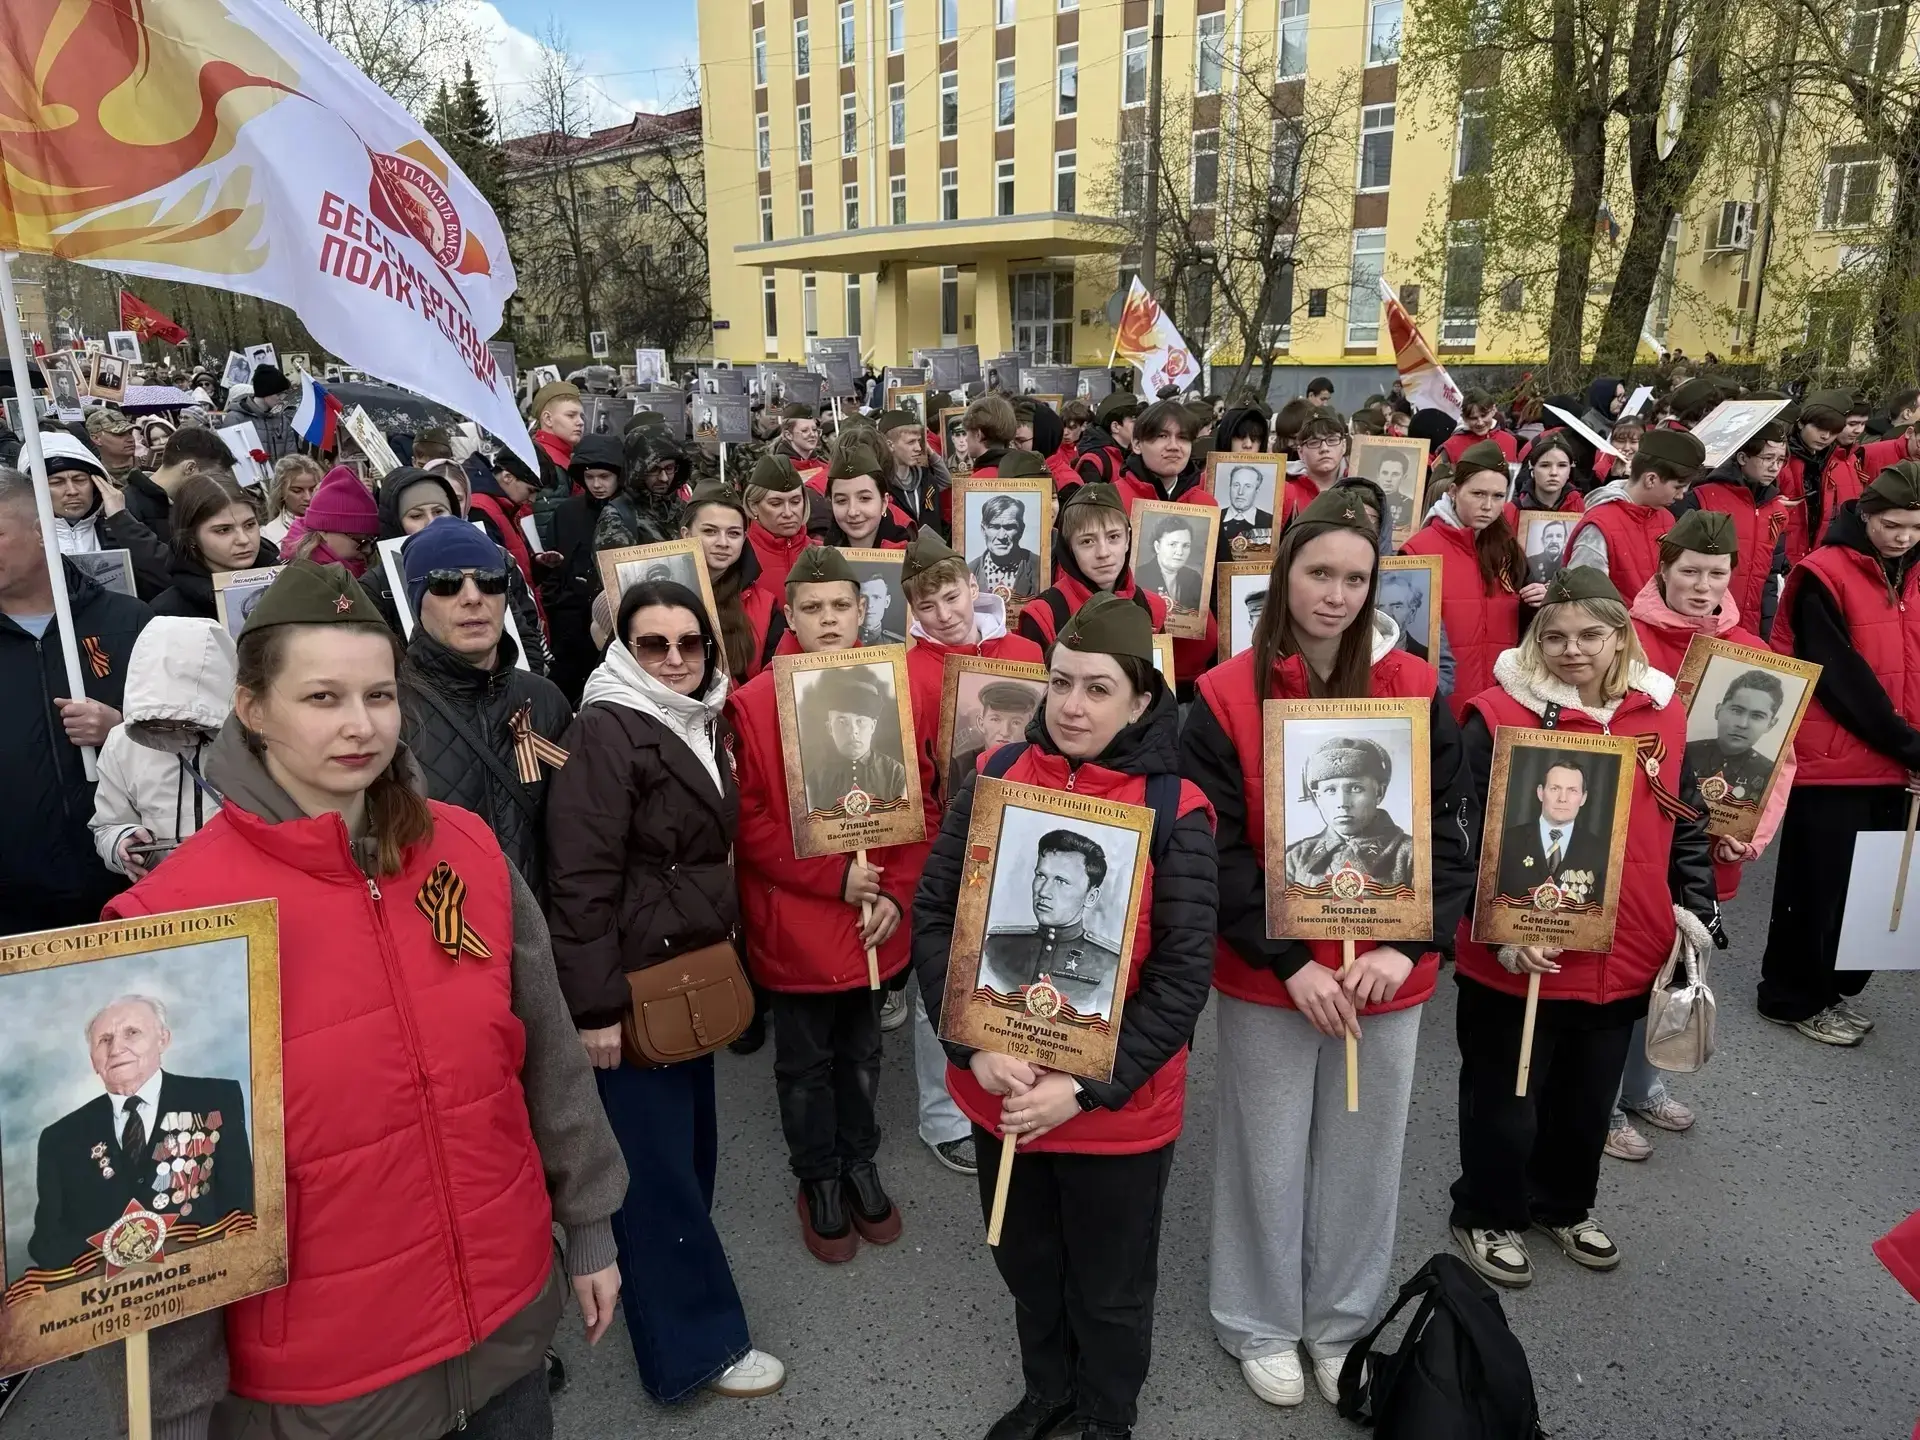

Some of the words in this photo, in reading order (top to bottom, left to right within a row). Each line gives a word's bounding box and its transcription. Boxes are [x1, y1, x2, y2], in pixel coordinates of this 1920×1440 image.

[402, 165, 454, 220] ПАМЯТЬ
[438, 223, 459, 266] ВМЕСЕ
[319, 233, 416, 311] ПОЛК
[791, 650, 861, 667] БЕССМЕРТНЫЙ
[861, 648, 889, 659] ПОЛК
[1709, 640, 1777, 667] БЕССМЕРТНЫЙ
[1777, 655, 1805, 673] ПОЛК
[961, 659, 1024, 674] БЕССМЕРТНЫЙ
[1286, 703, 1372, 714] БЕССМЕРТНЫЙ
[1373, 702, 1406, 712] ПОЛК
[1516, 731, 1591, 746] БЕССМЕРТНЫЙ
[1591, 737, 1619, 749] ПОЛК
[1000, 785, 1093, 813] БЕССМЕРТНЫЙ
[1093, 805, 1130, 820] ПОЛК
[827, 830, 861, 841] Василий
[862, 826, 894, 836] Агеевич
[839, 819, 881, 832] Уляшев
[842, 838, 860, 849] (1923
[863, 835, 881, 845] 1943)
[1320, 904, 1377, 915] Яковлев
[1296, 915, 1339, 924] Николай
[1340, 915, 1402, 925] Михайлович
[1520, 914, 1571, 927] Семёнов
[1, 920, 175, 962] БЕССМЕРТНЫЙ
[180, 912, 238, 933] ПОЛК
[1325, 925, 1346, 937] (1918
[1352, 925, 1373, 937] 1983)
[1512, 923, 1534, 933] Иван
[1535, 925, 1576, 936] Павлович
[1522, 932, 1541, 943] (1928
[1545, 935, 1563, 945] 1991)
[1004, 1015, 1069, 1042] Тимушев
[983, 1022, 1025, 1040] Георгий
[1026, 1033, 1084, 1056] Федорович
[1007, 1040, 1030, 1055] (1922
[1035, 1048, 1057, 1065] 1997)
[80, 1262, 193, 1307] Кулимов
[39, 1302, 116, 1336] Михаил
[120, 1268, 228, 1309] Васильевич
[91, 1313, 131, 1341] (1918
[143, 1296, 182, 1321] 2010)
